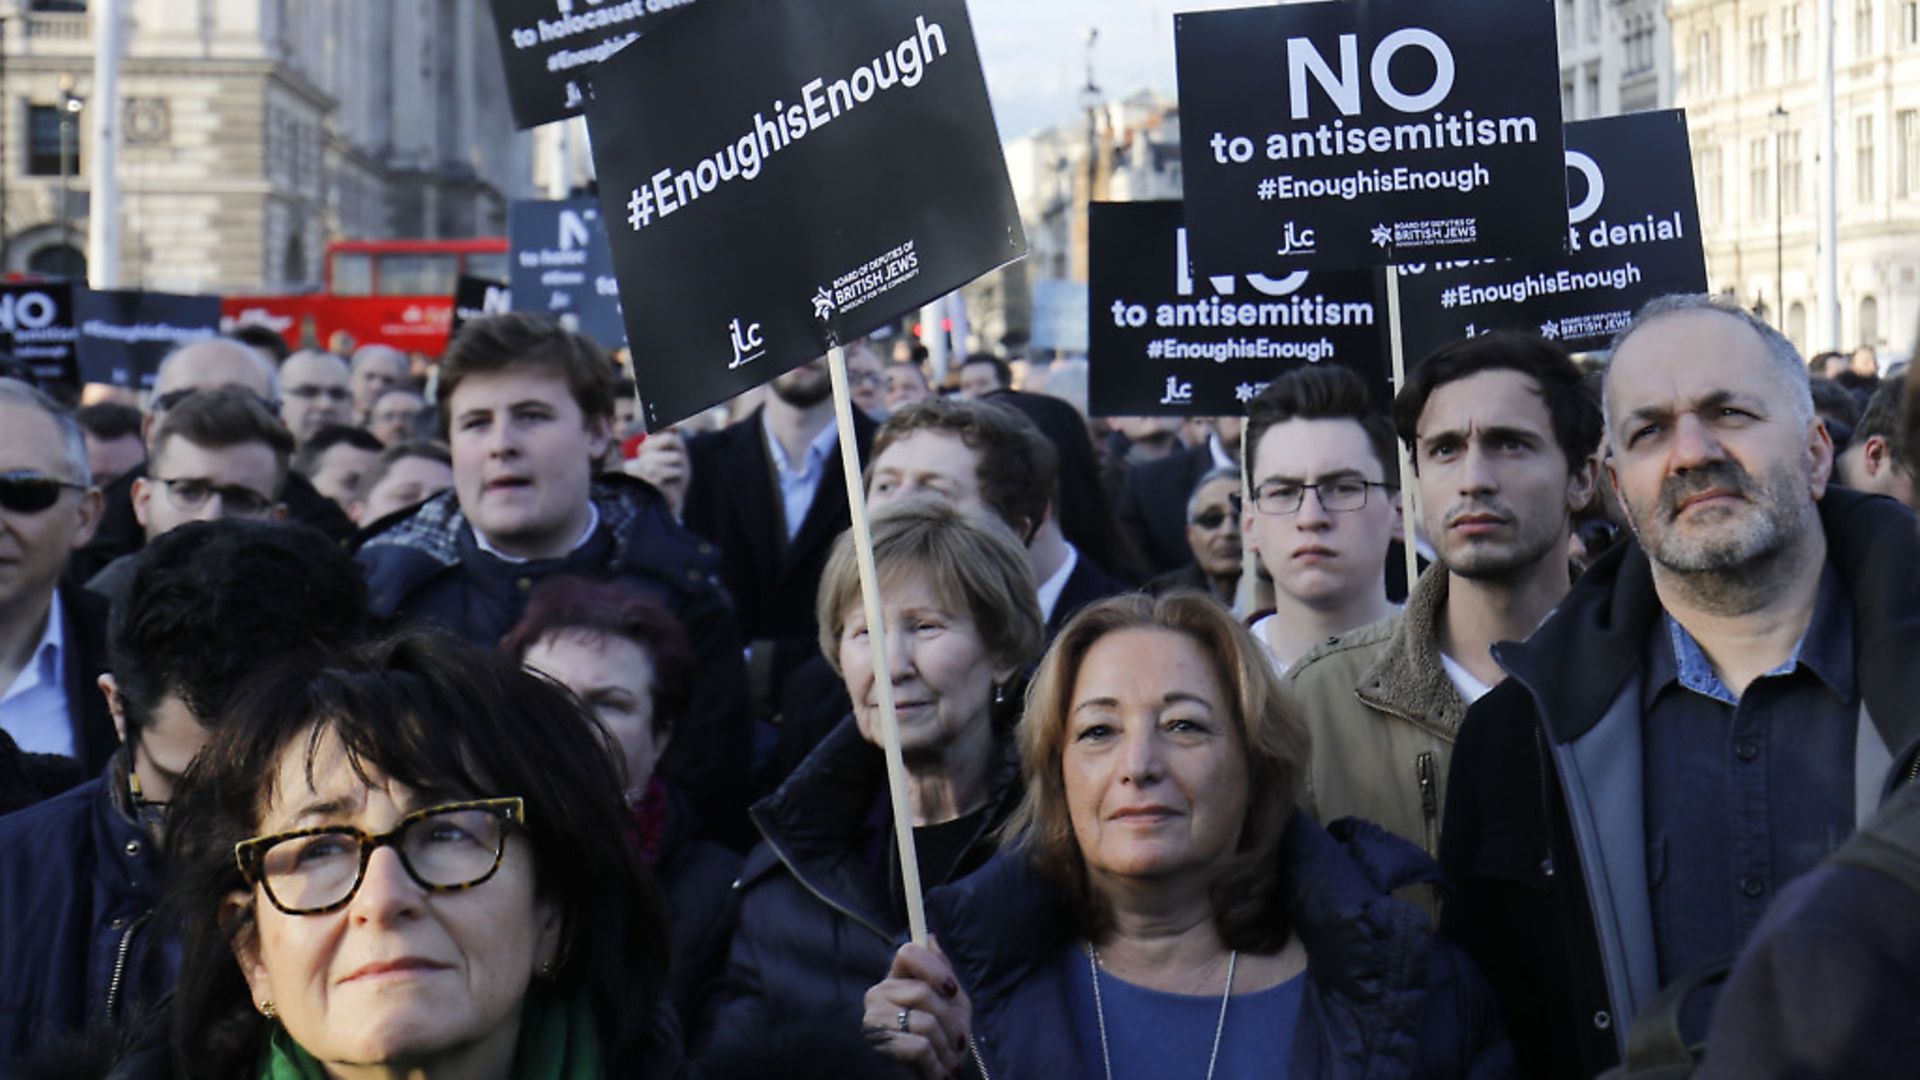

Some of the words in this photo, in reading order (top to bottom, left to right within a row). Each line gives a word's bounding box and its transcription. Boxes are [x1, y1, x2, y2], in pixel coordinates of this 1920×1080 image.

[511, 28, 538, 49] to
[537, 0, 645, 42] holocaust
[1287, 27, 1456, 119] NO
[626, 16, 948, 230] #EnoughisEnough
[1210, 132, 1254, 164] to
[1266, 110, 1538, 160] antisemitism
[1257, 162, 1490, 200] #EnoughisEnough
[1394, 228, 1442, 241] BRITISH
[1444, 225, 1477, 239] JEWS
[1589, 211, 1683, 250] denial
[835, 268, 884, 306] BRITISH
[884, 251, 918, 281] JEWS
[1441, 262, 1642, 308] #EnoughisEnough
[1111, 300, 1148, 327] to
[1155, 294, 1375, 326] antisemitism
[727, 318, 764, 370] jlc
[1147, 337, 1334, 362] #EnoughisEnough
